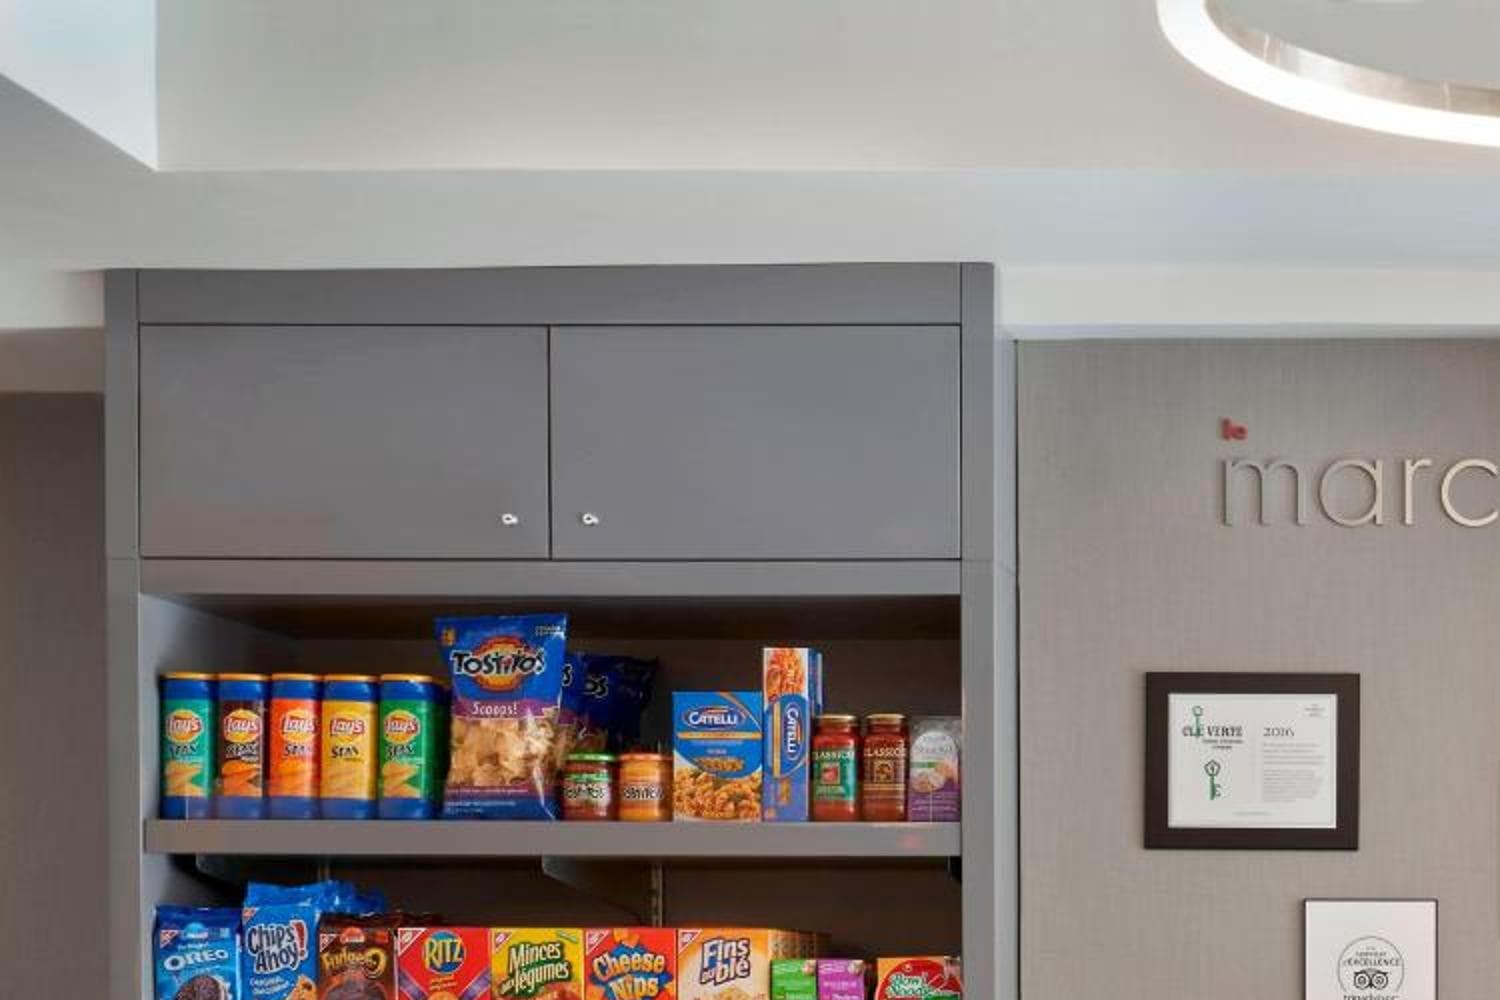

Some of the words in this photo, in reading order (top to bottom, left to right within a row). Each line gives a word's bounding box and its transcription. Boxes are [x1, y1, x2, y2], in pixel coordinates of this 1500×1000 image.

[1207, 725, 1243, 737] VERTE
[1263, 727, 1295, 737] 2016
[248, 923, 295, 954] Chips
[425, 937, 464, 968] RITZ
[702, 937, 750, 968] Fins
[164, 949, 229, 971] OREO
[509, 942, 562, 974] Minces
[592, 950, 666, 982] Cheese
[714, 955, 749, 985] blé
[514, 961, 570, 994] légumes
